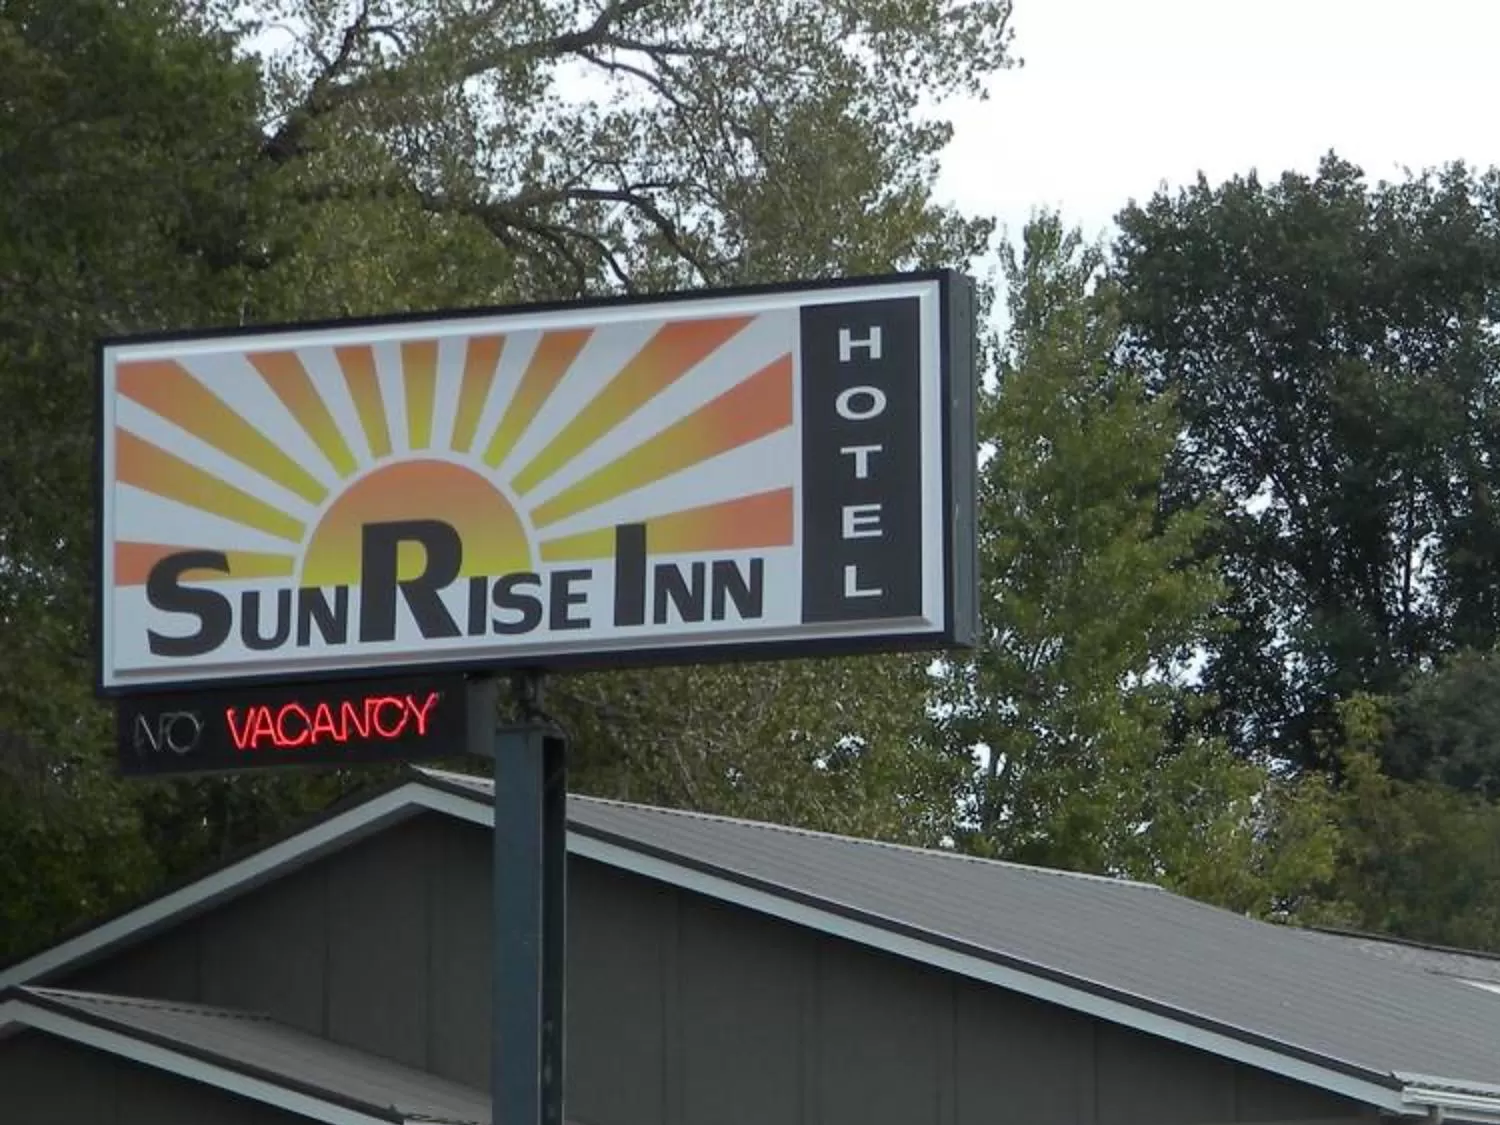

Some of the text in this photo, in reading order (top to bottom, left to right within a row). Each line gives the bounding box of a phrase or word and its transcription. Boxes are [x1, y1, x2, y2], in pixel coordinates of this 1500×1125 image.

[835, 326, 887, 598] HOTEL
[613, 522, 764, 627] INN
[134, 692, 440, 754] NO VACANCY
